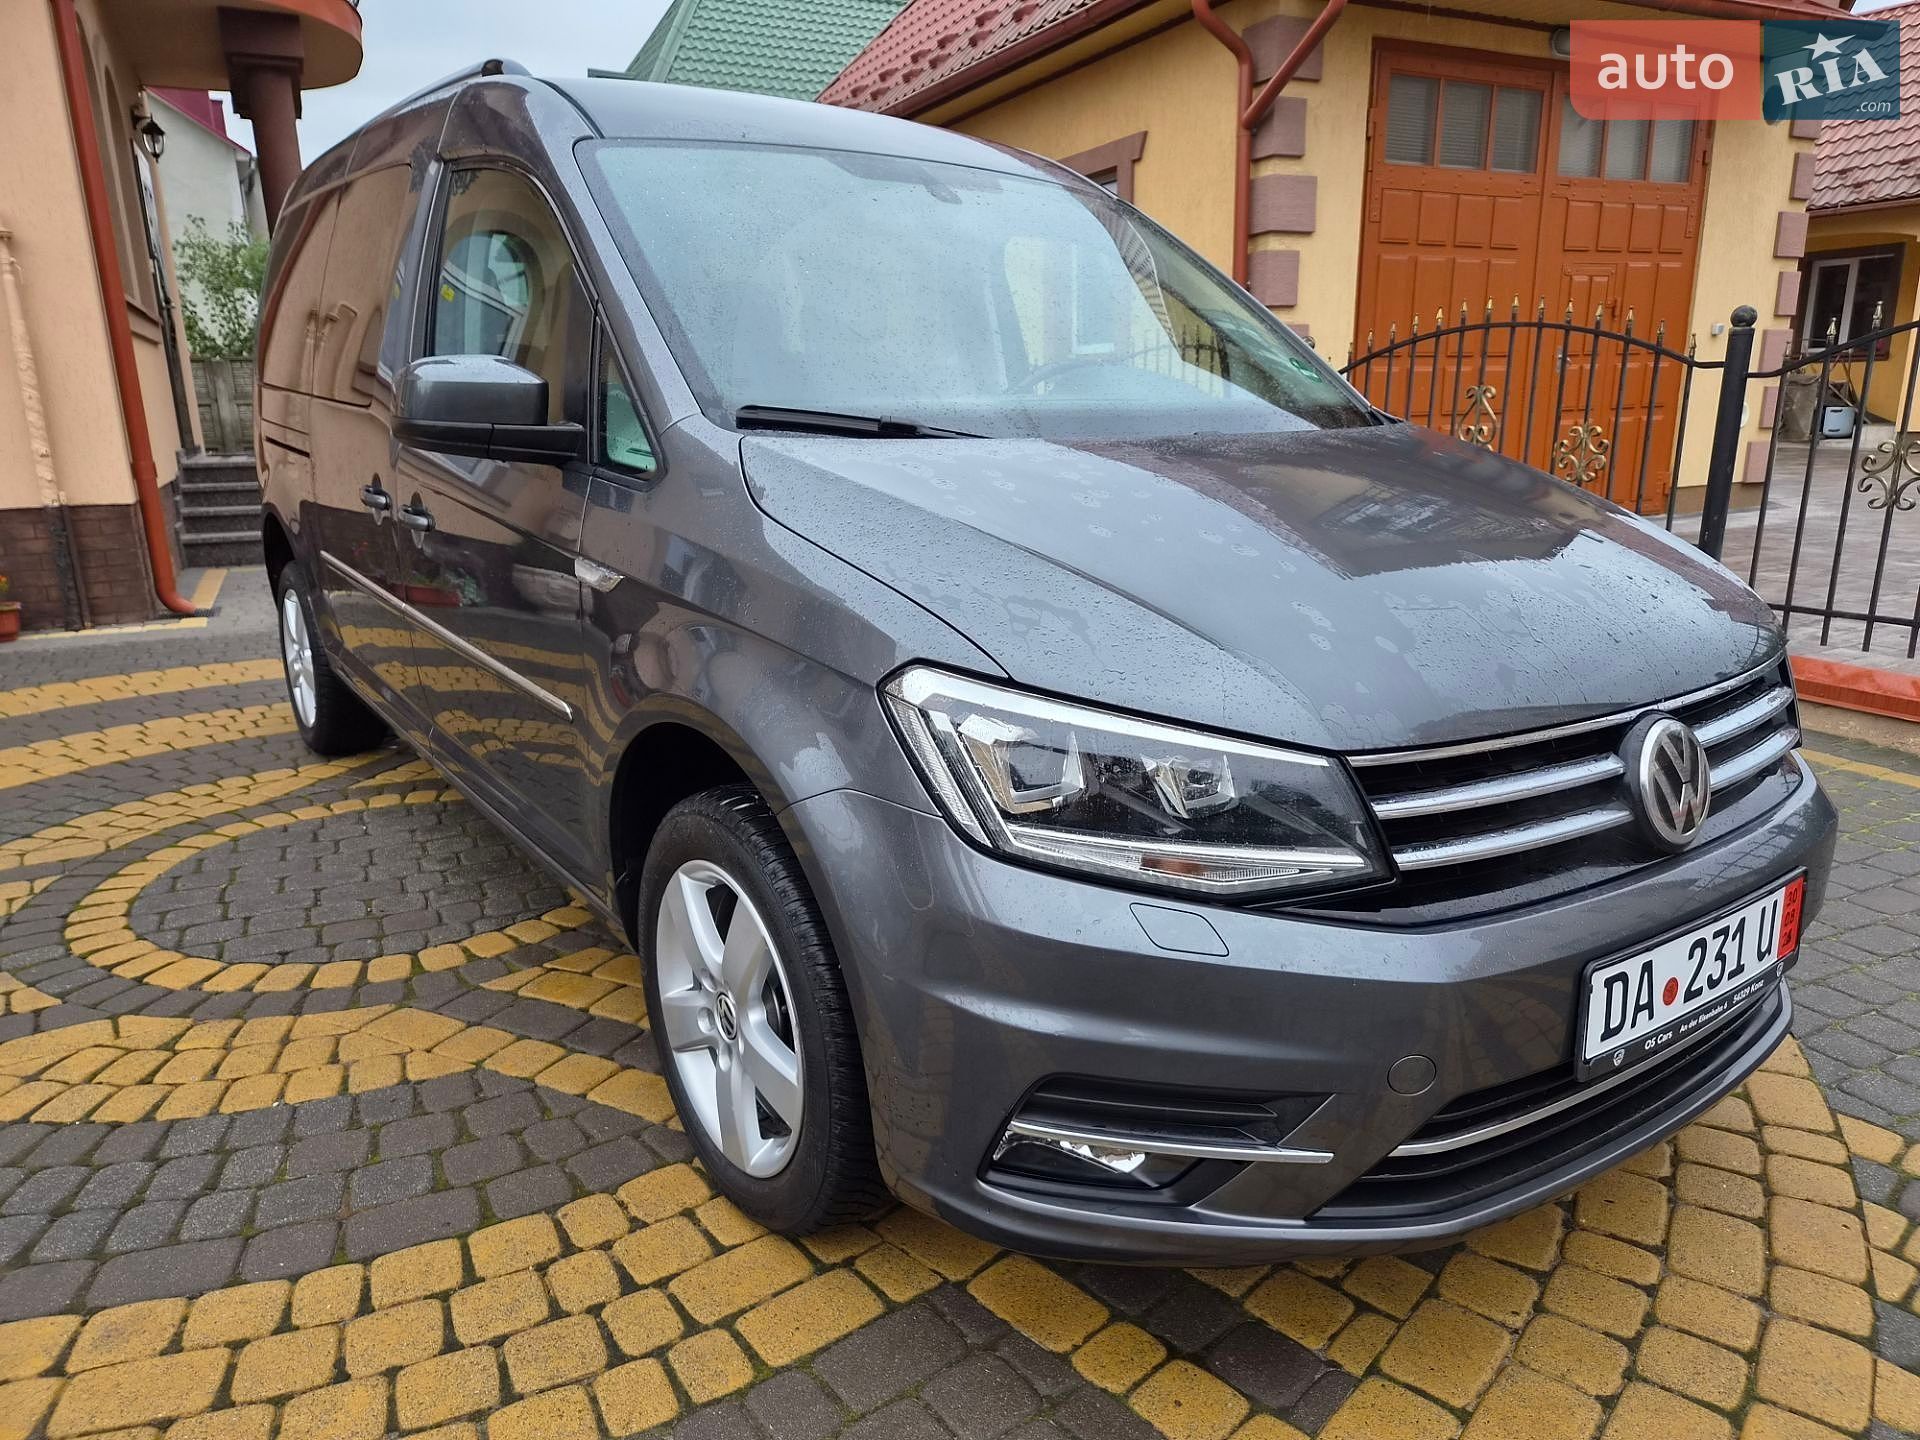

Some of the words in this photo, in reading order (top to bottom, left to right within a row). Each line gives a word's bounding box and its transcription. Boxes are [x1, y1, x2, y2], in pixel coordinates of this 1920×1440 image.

[1600, 959, 1655, 1042] DA
[1683, 916, 1746, 1004] 231
[1756, 899, 1778, 962] U
[1657, 1031, 1673, 1044] Cars
